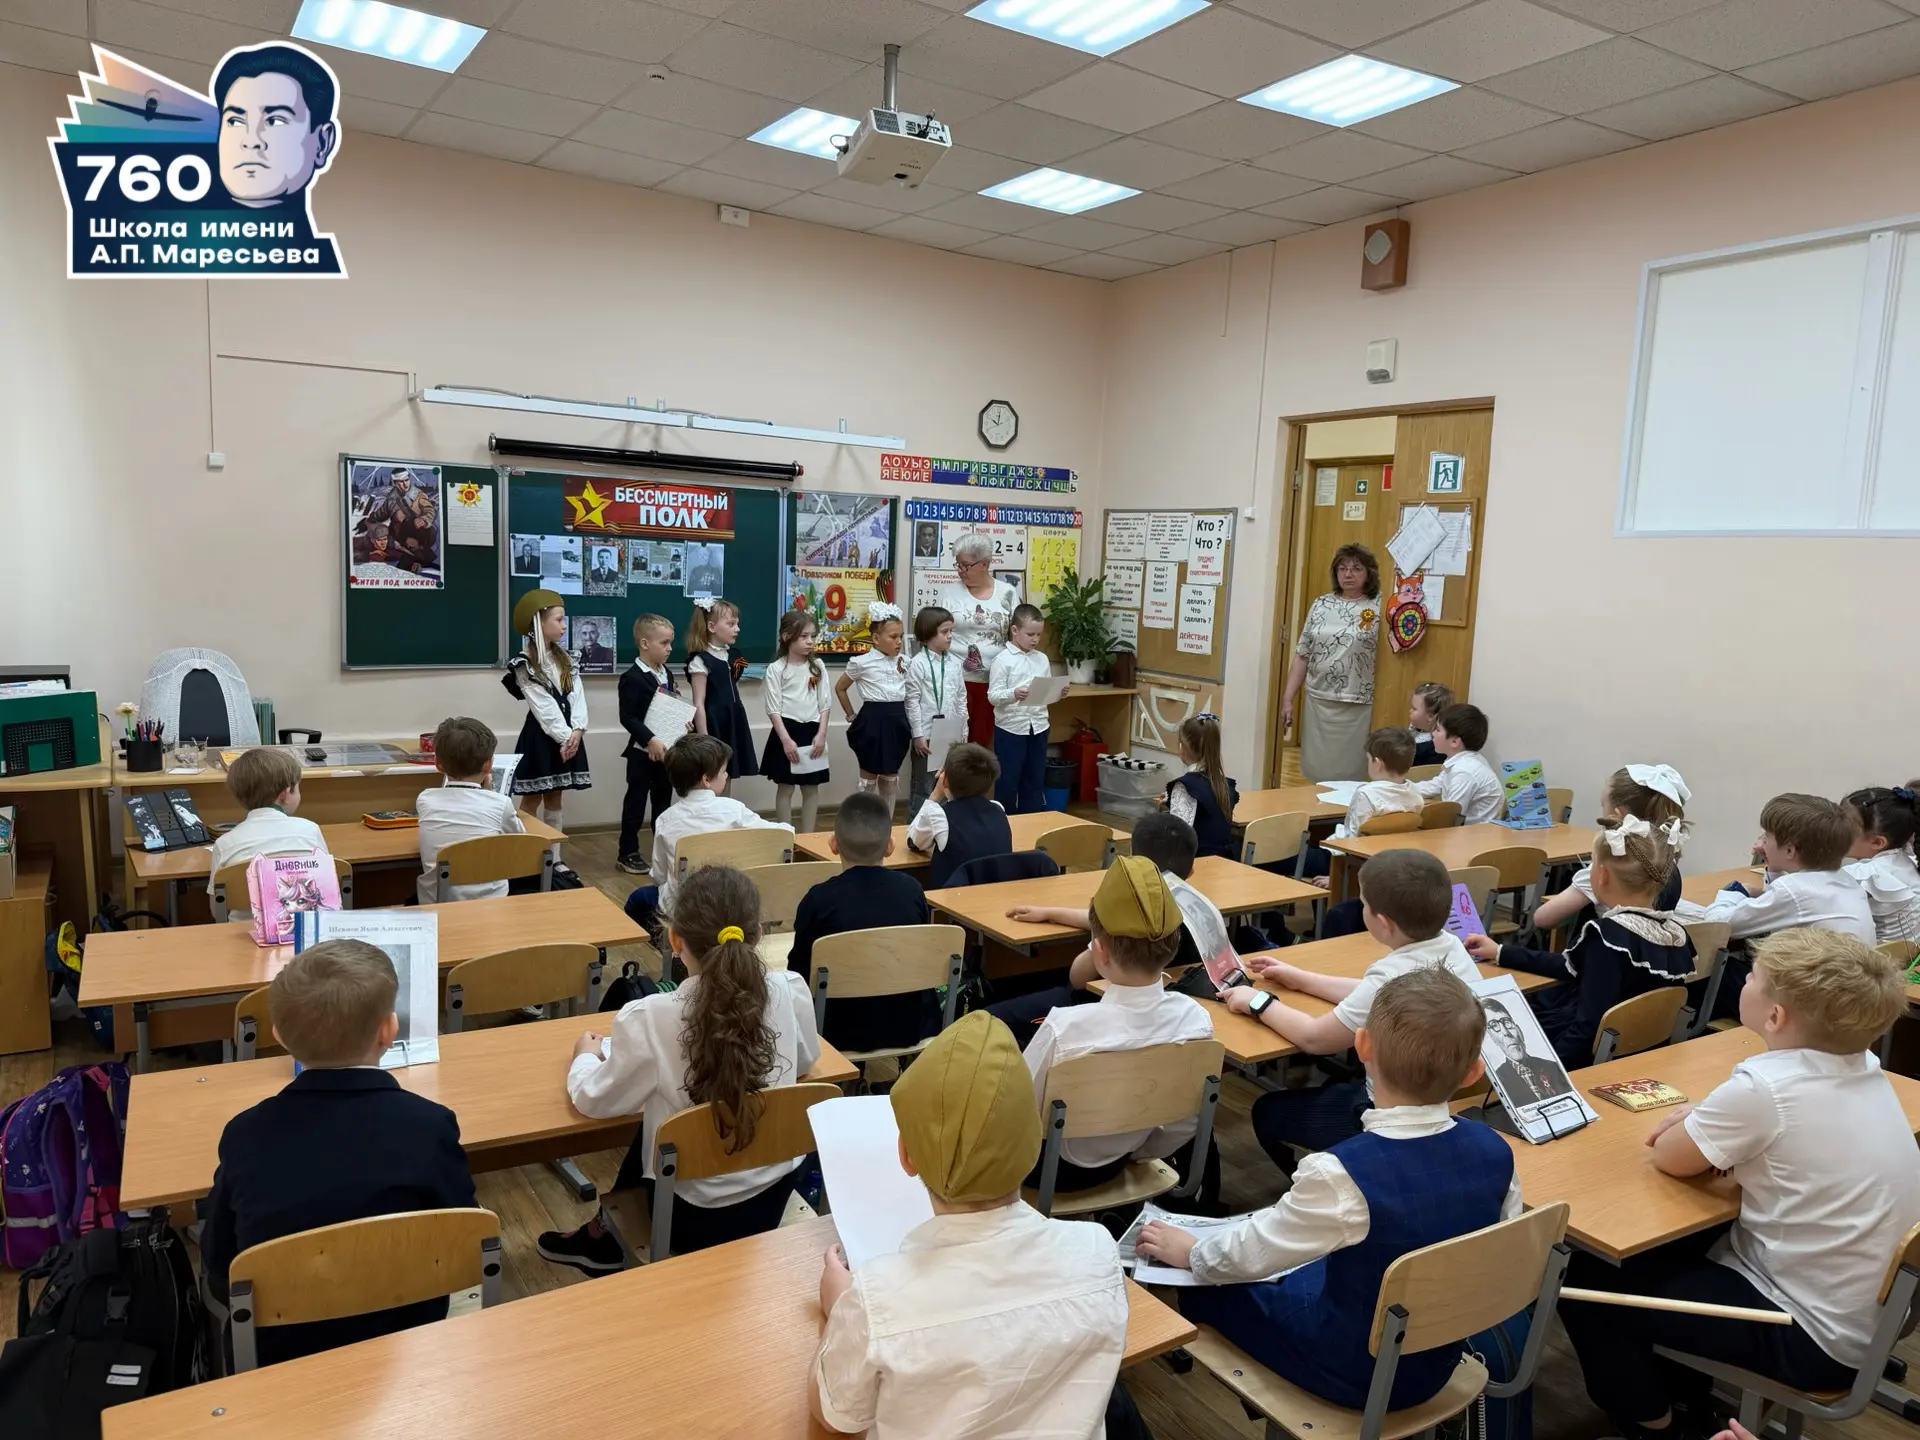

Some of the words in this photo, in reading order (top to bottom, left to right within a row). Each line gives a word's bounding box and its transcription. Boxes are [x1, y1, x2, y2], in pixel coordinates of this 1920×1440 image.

[614, 486, 729, 511] БЕССМЕРТНЫЙ
[639, 504, 709, 529] ПОЛК
[1197, 520, 1214, 531] Кто
[996, 541, 1002, 554] 2
[1017, 542, 1024, 554] 4
[1195, 537, 1213, 549] Что
[801, 568, 842, 579] Праздником
[825, 584, 846, 621] 9
[1179, 632, 1208, 641] ДЕЙСТВИЕ
